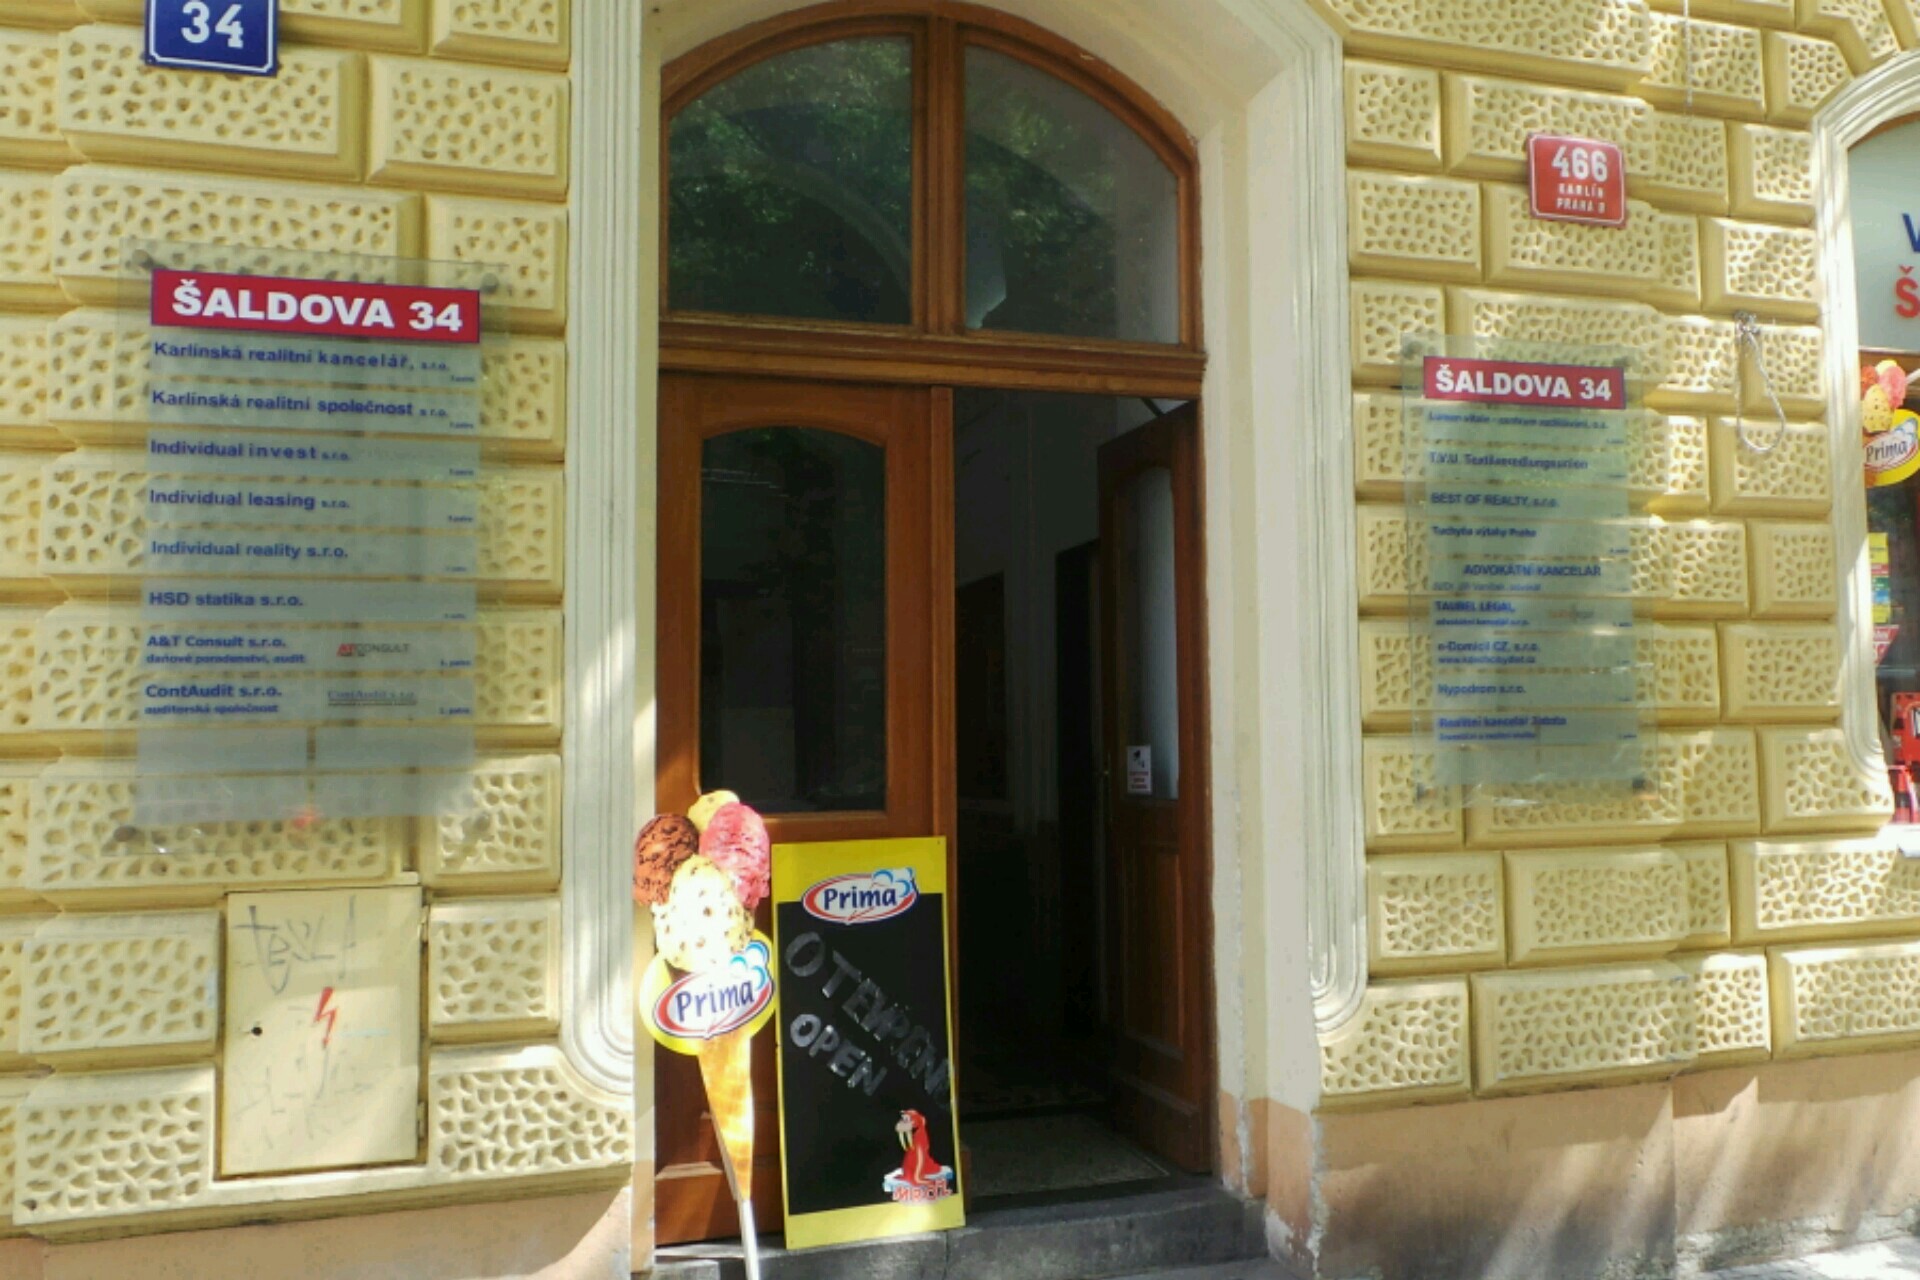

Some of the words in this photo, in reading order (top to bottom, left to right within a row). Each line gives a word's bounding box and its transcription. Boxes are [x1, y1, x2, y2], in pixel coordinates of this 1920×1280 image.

[180, 1, 244, 48] 34
[1552, 145, 1608, 182] 466
[1556, 198, 1594, 212] PRAHA
[172, 278, 395, 329] ŠALDOVA
[408, 301, 463, 332] 34
[154, 341, 242, 361] Karlínská
[249, 347, 313, 363] realitní
[1435, 364, 1571, 399] ŠALDOVA
[1579, 378, 1612, 401] 34
[152, 390, 241, 408] Karlínská
[246, 396, 311, 411] realitní
[317, 399, 414, 416] společnost
[150, 439, 243, 457] Individual
[249, 443, 318, 460] invest
[1866, 440, 1908, 463] Prima
[150, 489, 242, 506] Individual
[248, 492, 316, 511] leasing
[1464, 493, 1482, 505] OF
[152, 541, 240, 556] Individual
[246, 543, 301, 560] reality
[306, 546, 348, 559] s.r.o.
[148, 591, 190, 607] HSD
[195, 591, 256, 607] statika
[259, 594, 304, 607] s.r.o.
[146, 635, 181, 648] A&T
[184, 634, 244, 648] Consult
[247, 637, 287, 649] s.r.o.
[145, 682, 236, 698] ContAudit
[239, 685, 283, 698] s.r.o.
[823, 886, 898, 911] Prima
[676, 980, 755, 1022] Prima
[789, 1013, 888, 1097] OPEN
